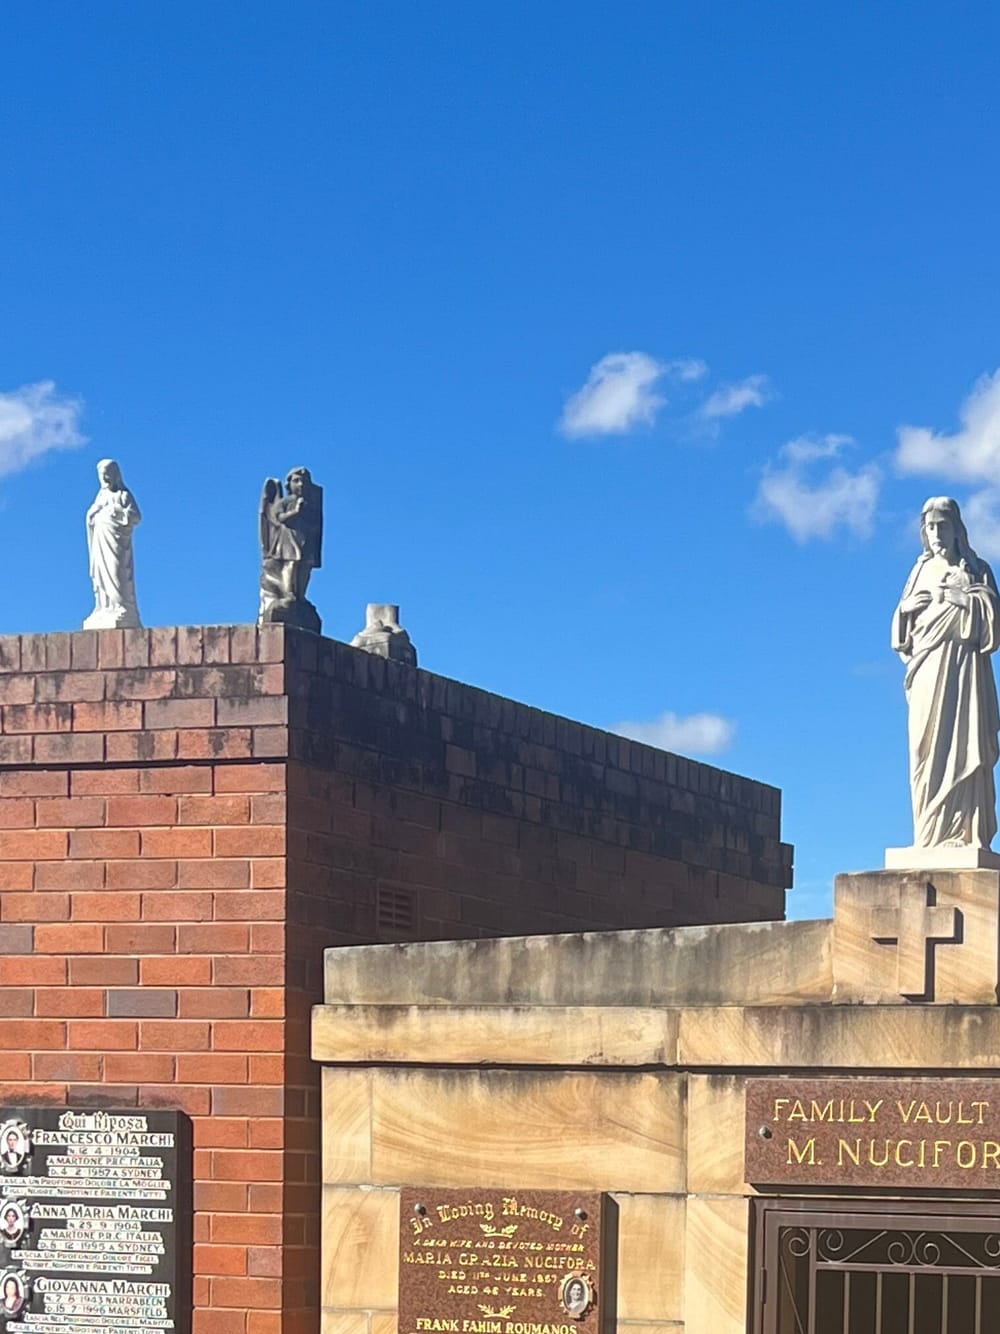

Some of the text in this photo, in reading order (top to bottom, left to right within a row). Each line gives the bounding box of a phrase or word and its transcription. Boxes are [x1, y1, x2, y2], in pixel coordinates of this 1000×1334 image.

[773, 1098, 883, 1123] FAMILY
[896, 1100, 990, 1125] VAULT
[94, 1113, 145, 1131] Riposa
[35, 1131, 171, 1146] FRANCESCO MARCHI
[786, 1138, 823, 1166] M.
[33, 1206, 170, 1220] ANNA MARIA MARCHI
[436, 1200, 495, 1222] Loving
[502, 1197, 563, 1231] Memory
[403, 1252, 596, 1271] MARIA GRAZIA NUCIFORA
[438, 1271, 466, 1280] DIED
[37, 1279, 168, 1295] GIOVANNA MARCHI
[448, 1285, 478, 1294] AGED
[416, 1318, 459, 1331] FRANK
[463, 1320, 501, 1333] FAHIM
